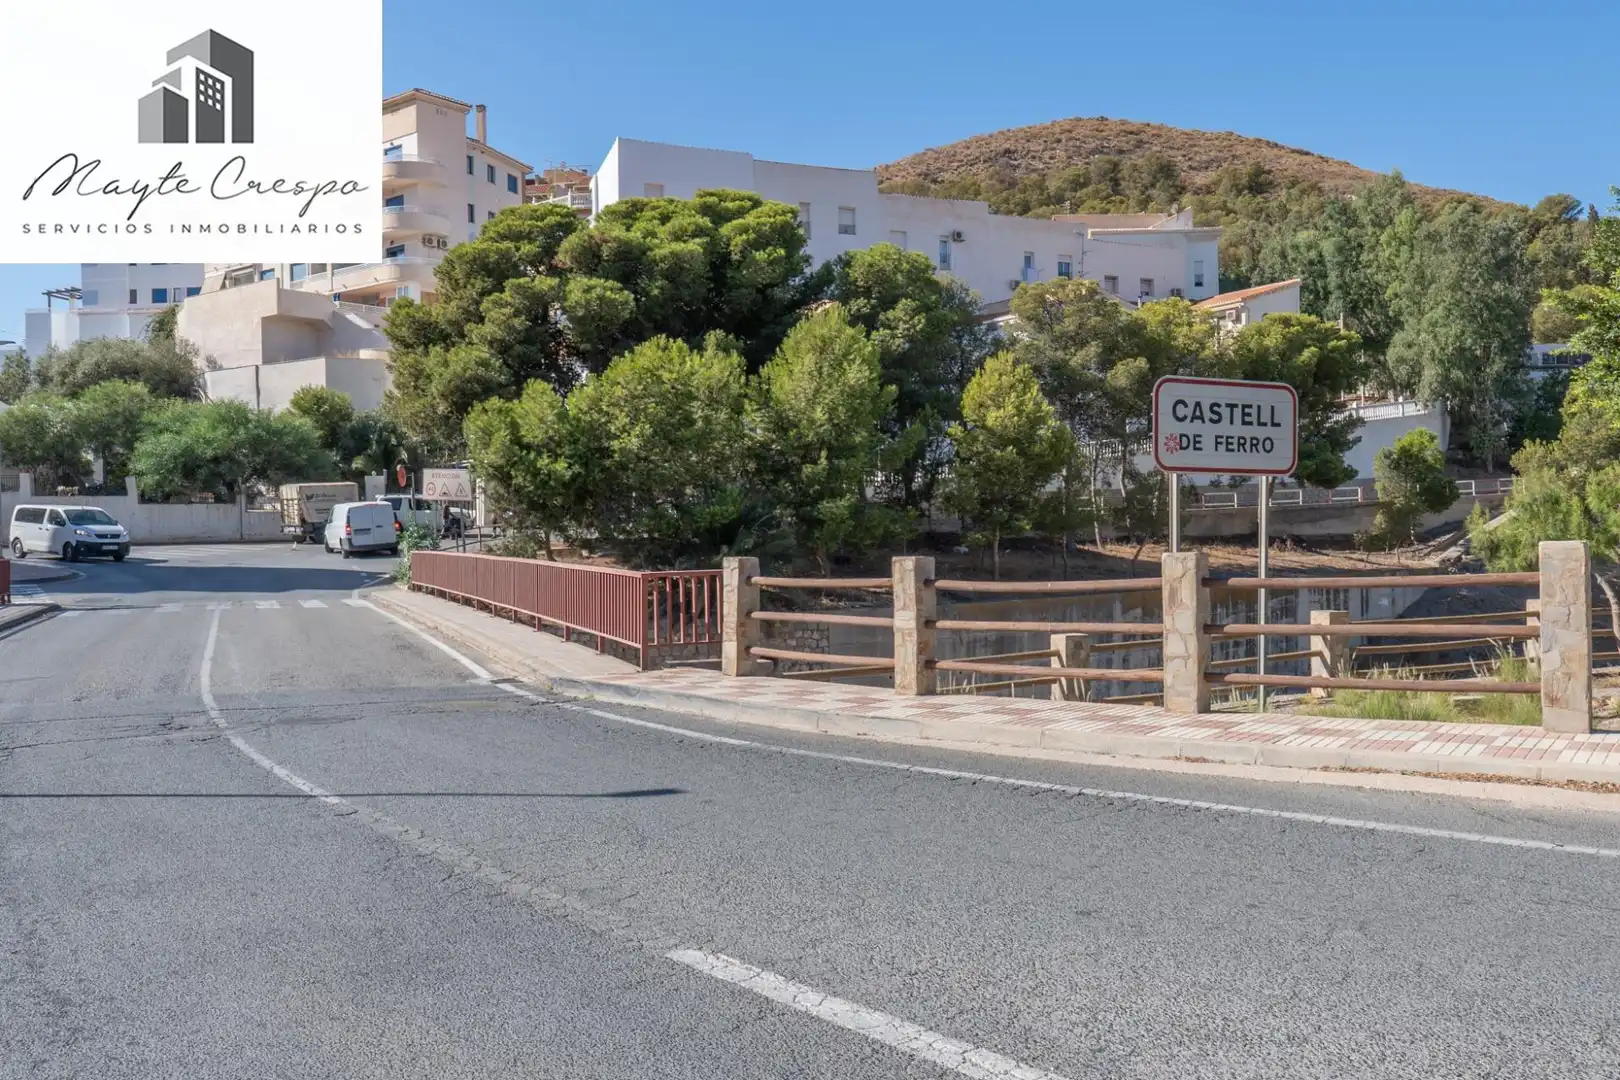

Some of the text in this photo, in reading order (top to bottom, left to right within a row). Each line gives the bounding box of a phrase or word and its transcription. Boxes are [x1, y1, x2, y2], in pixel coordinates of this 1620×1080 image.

[1172, 398, 1282, 428] CASTELL
[1179, 433, 1274, 454] DE FERRO
